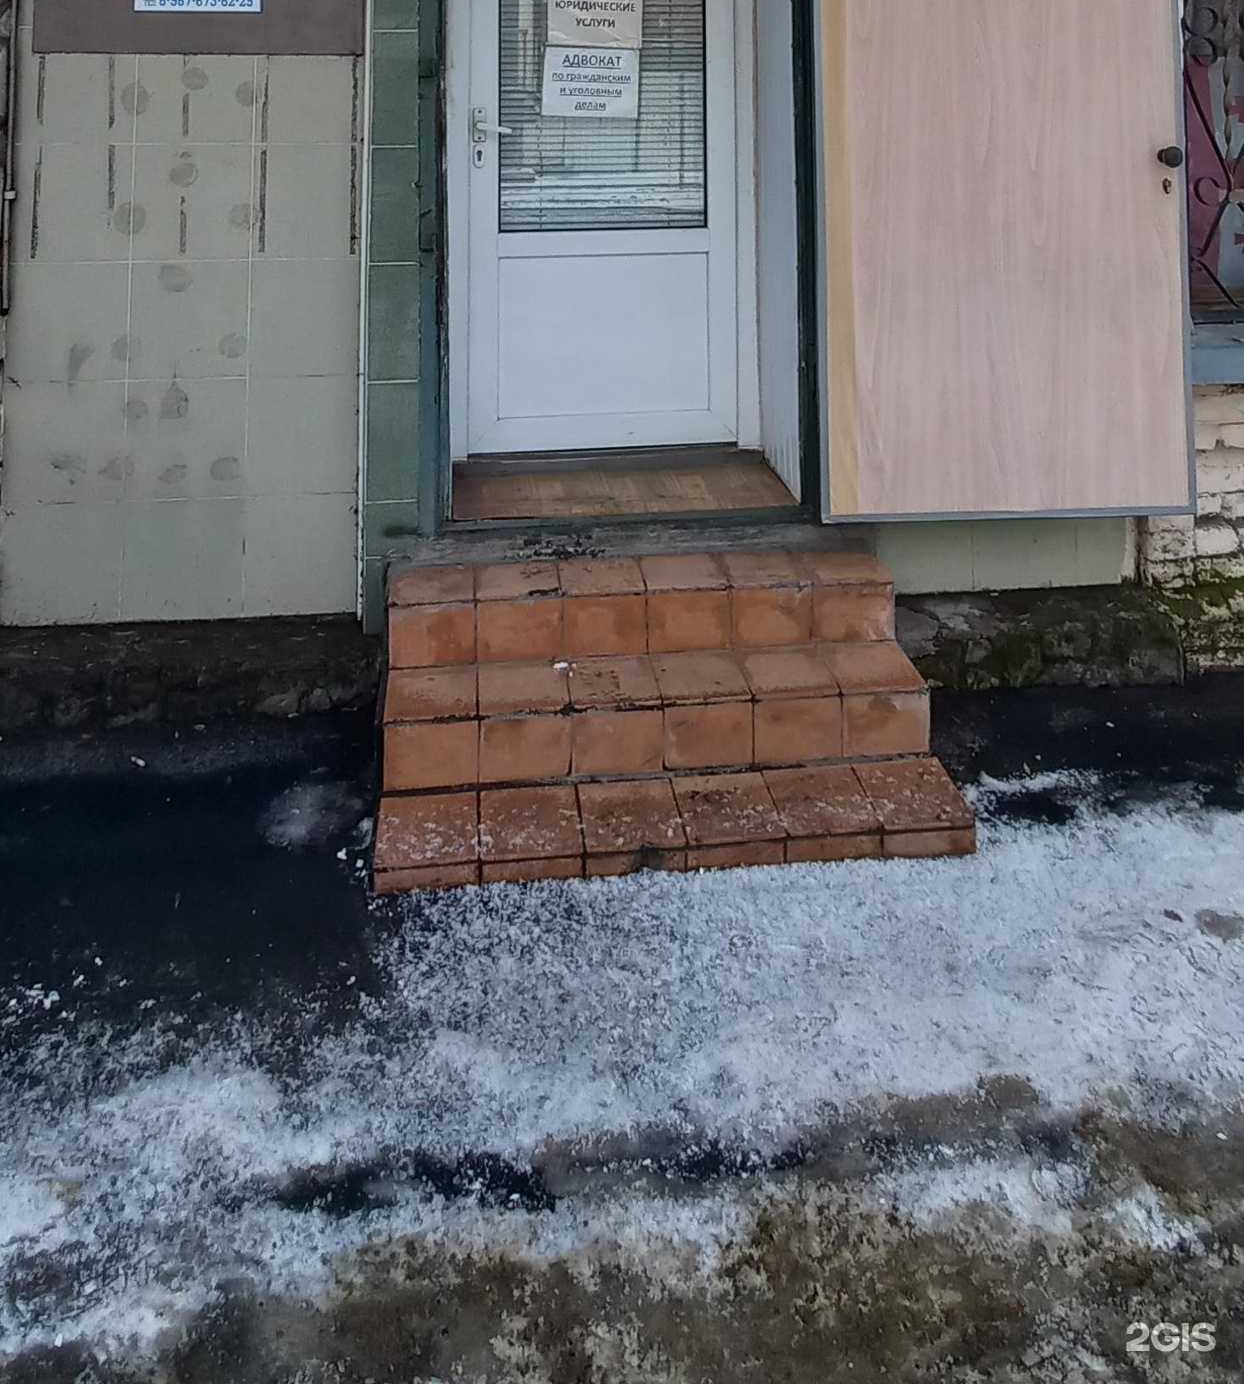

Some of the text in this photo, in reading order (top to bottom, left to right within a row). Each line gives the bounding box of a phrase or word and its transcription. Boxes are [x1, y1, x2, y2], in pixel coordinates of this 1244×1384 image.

[555, 0, 636, 13] ЮРИДИЧЕСКИЕ
[575, 18, 615, 28] УСЛУГИ
[562, 54, 622, 67] АДВОКАТ
[552, 72, 631, 83] по гражданским
[559, 87, 622, 98] и уголовным
[574, 101, 606, 112] делам
